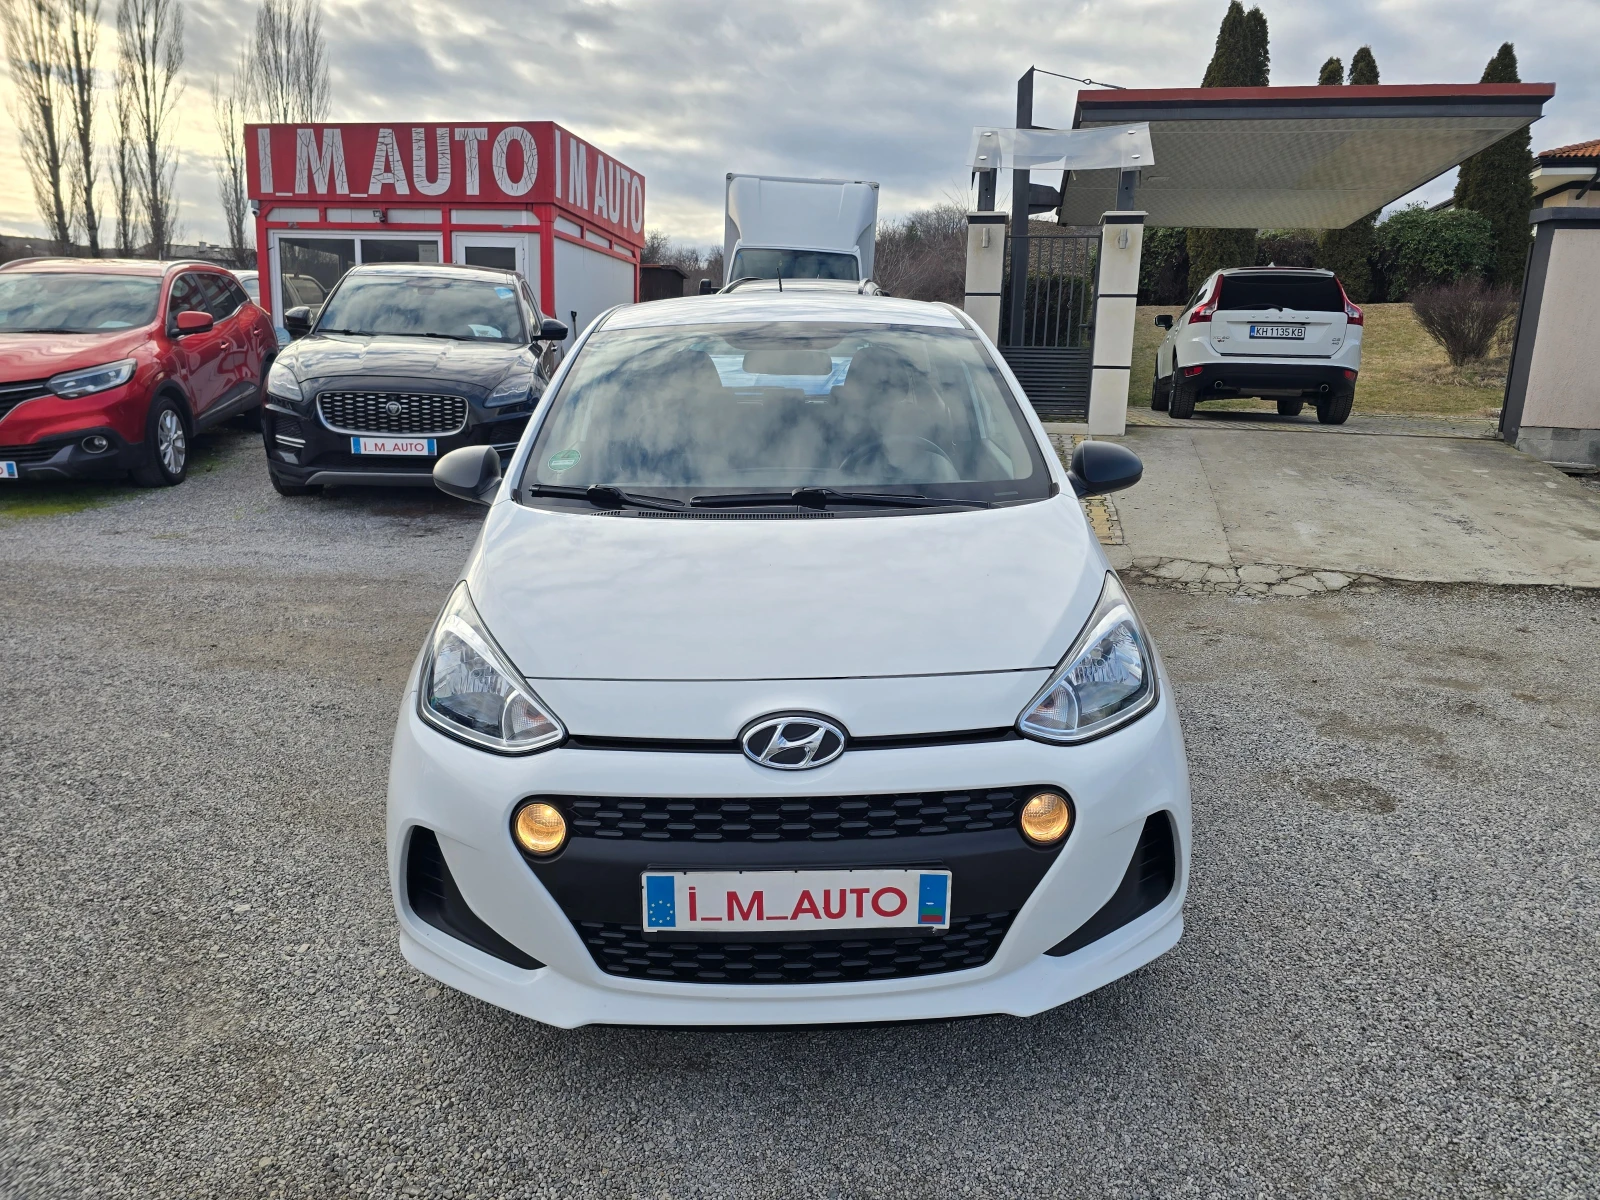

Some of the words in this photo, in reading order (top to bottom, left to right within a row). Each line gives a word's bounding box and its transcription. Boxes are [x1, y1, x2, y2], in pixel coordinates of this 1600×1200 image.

[568, 137, 588, 211] M
[593, 154, 643, 234] AUTO
[1256, 327, 1269, 336] KH
[1270, 327, 1291, 337] 1135
[1291, 328, 1304, 337] KB
